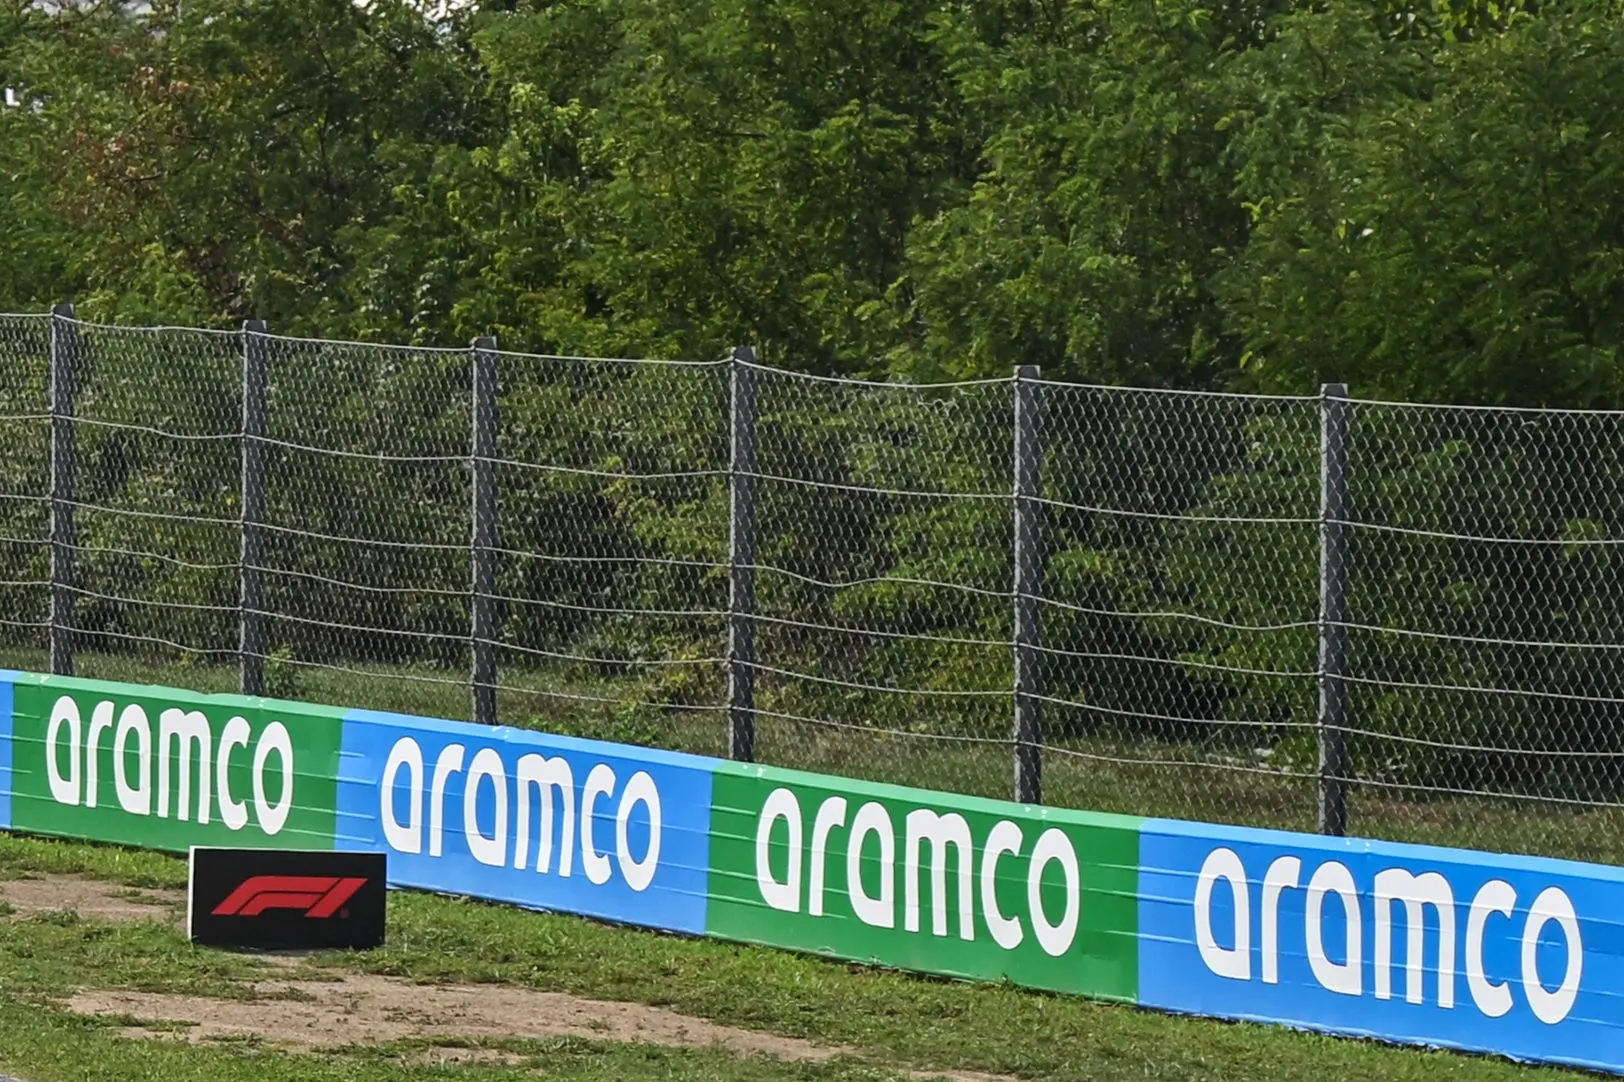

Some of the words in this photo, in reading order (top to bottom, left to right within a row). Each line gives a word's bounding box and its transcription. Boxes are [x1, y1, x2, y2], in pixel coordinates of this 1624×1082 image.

[46, 695, 293, 836] aramco
[381, 736, 662, 892] aramco
[755, 788, 1080, 957] aramco
[1194, 847, 1584, 1025] aramco
